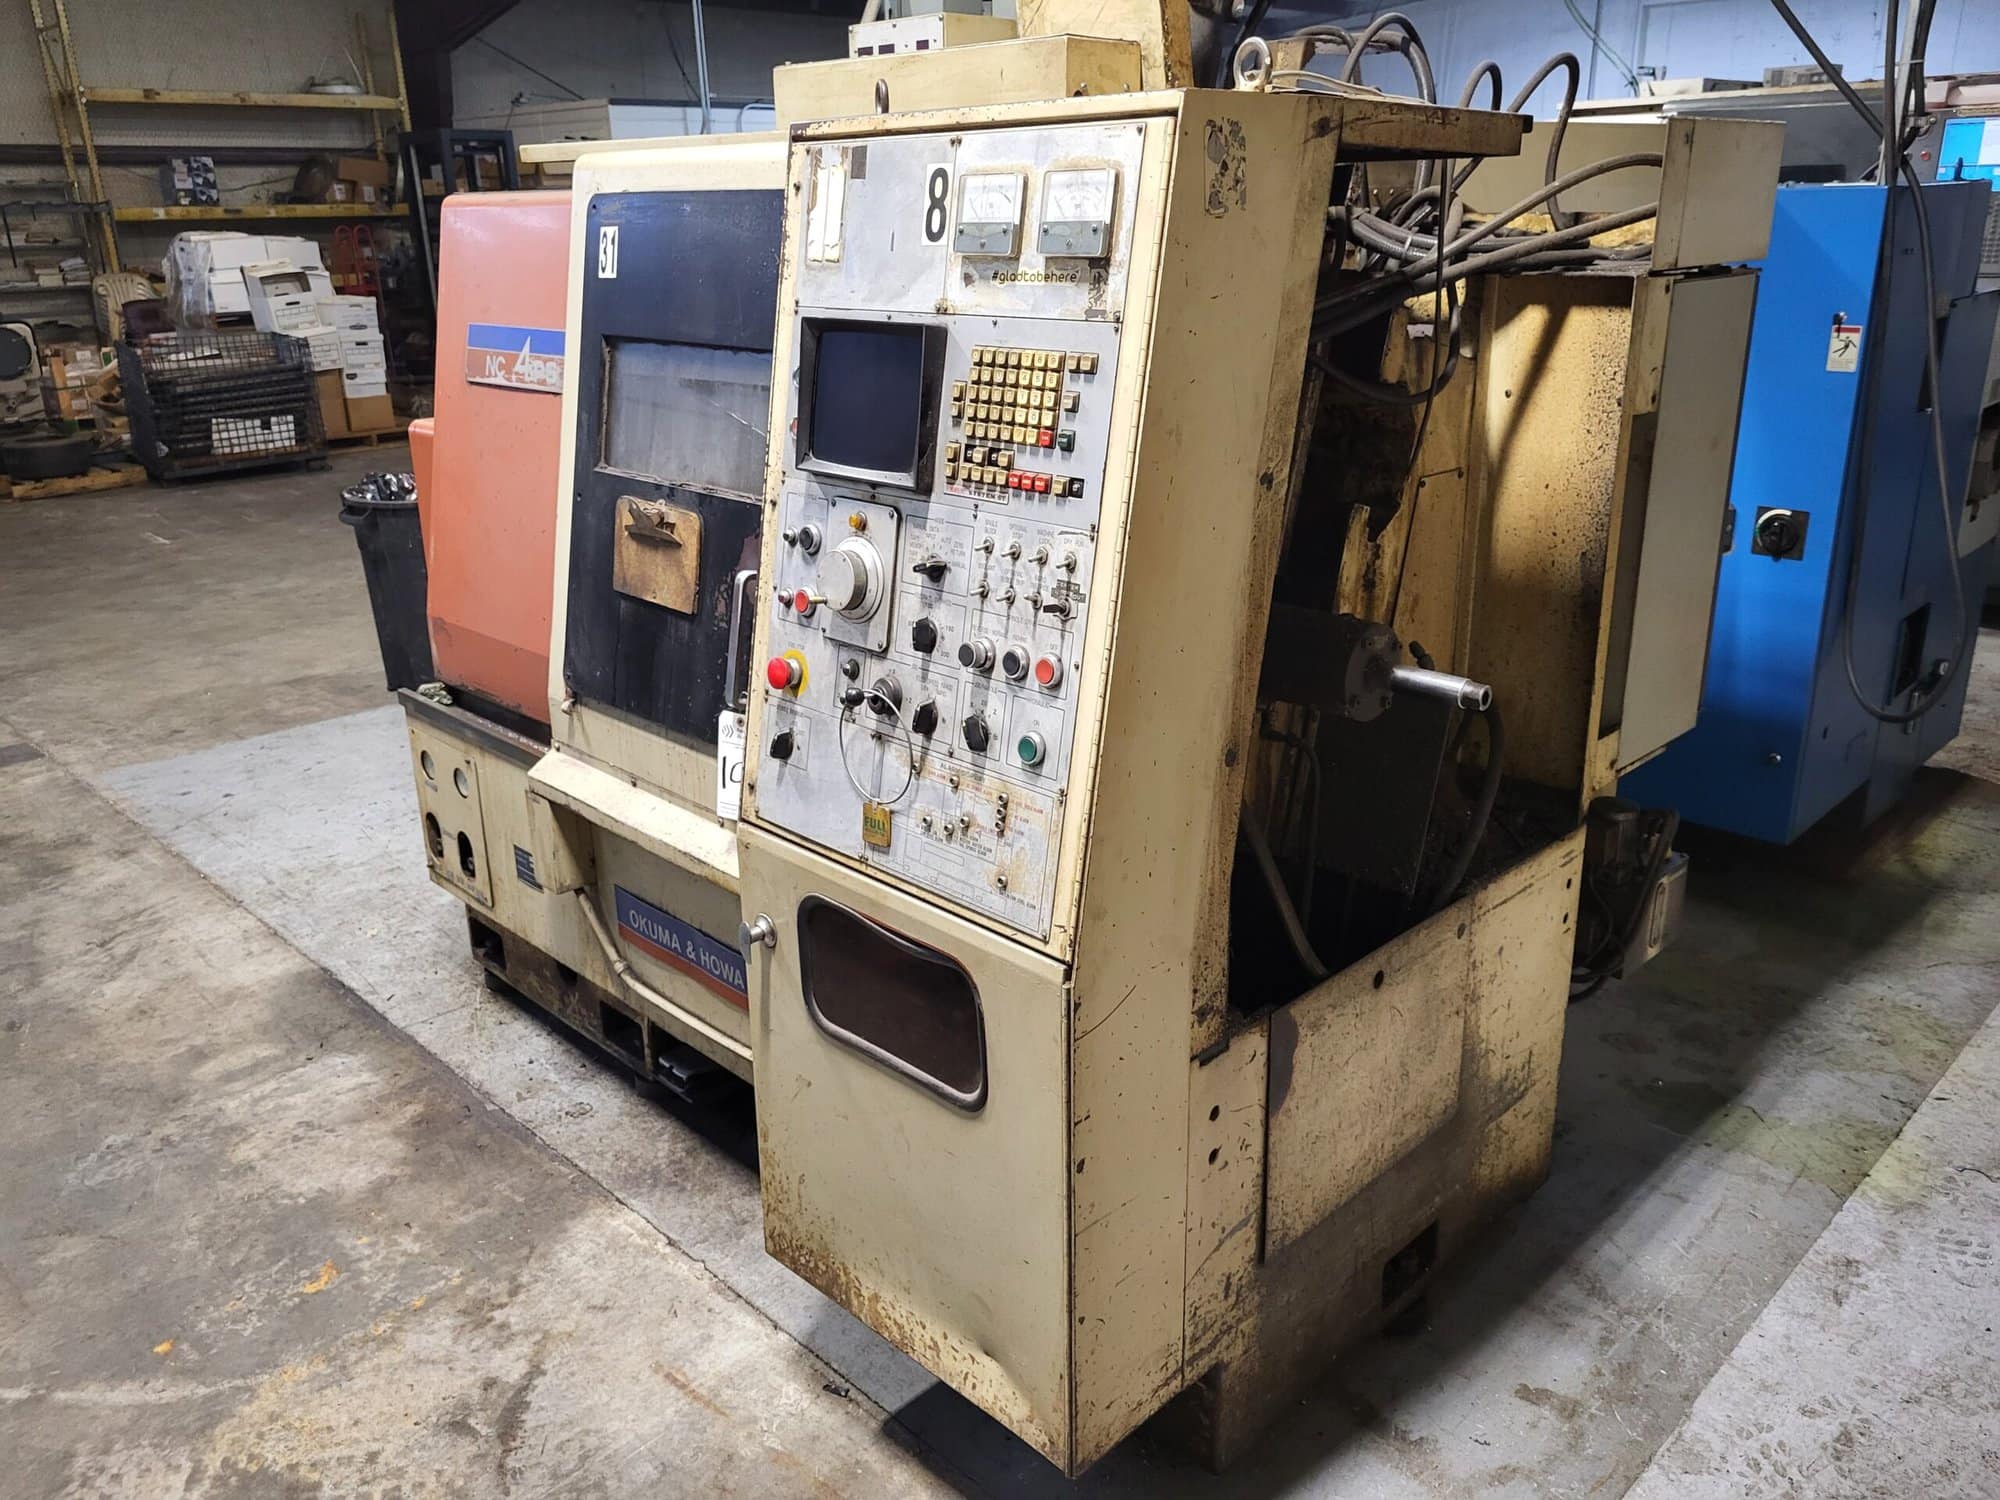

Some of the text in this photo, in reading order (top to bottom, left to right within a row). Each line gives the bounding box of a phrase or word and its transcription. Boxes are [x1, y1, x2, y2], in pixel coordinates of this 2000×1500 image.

[925, 167, 949, 243] 8
[600, 229, 617, 275] 31
[628, 909, 745, 990] OKUMA & HOWA
